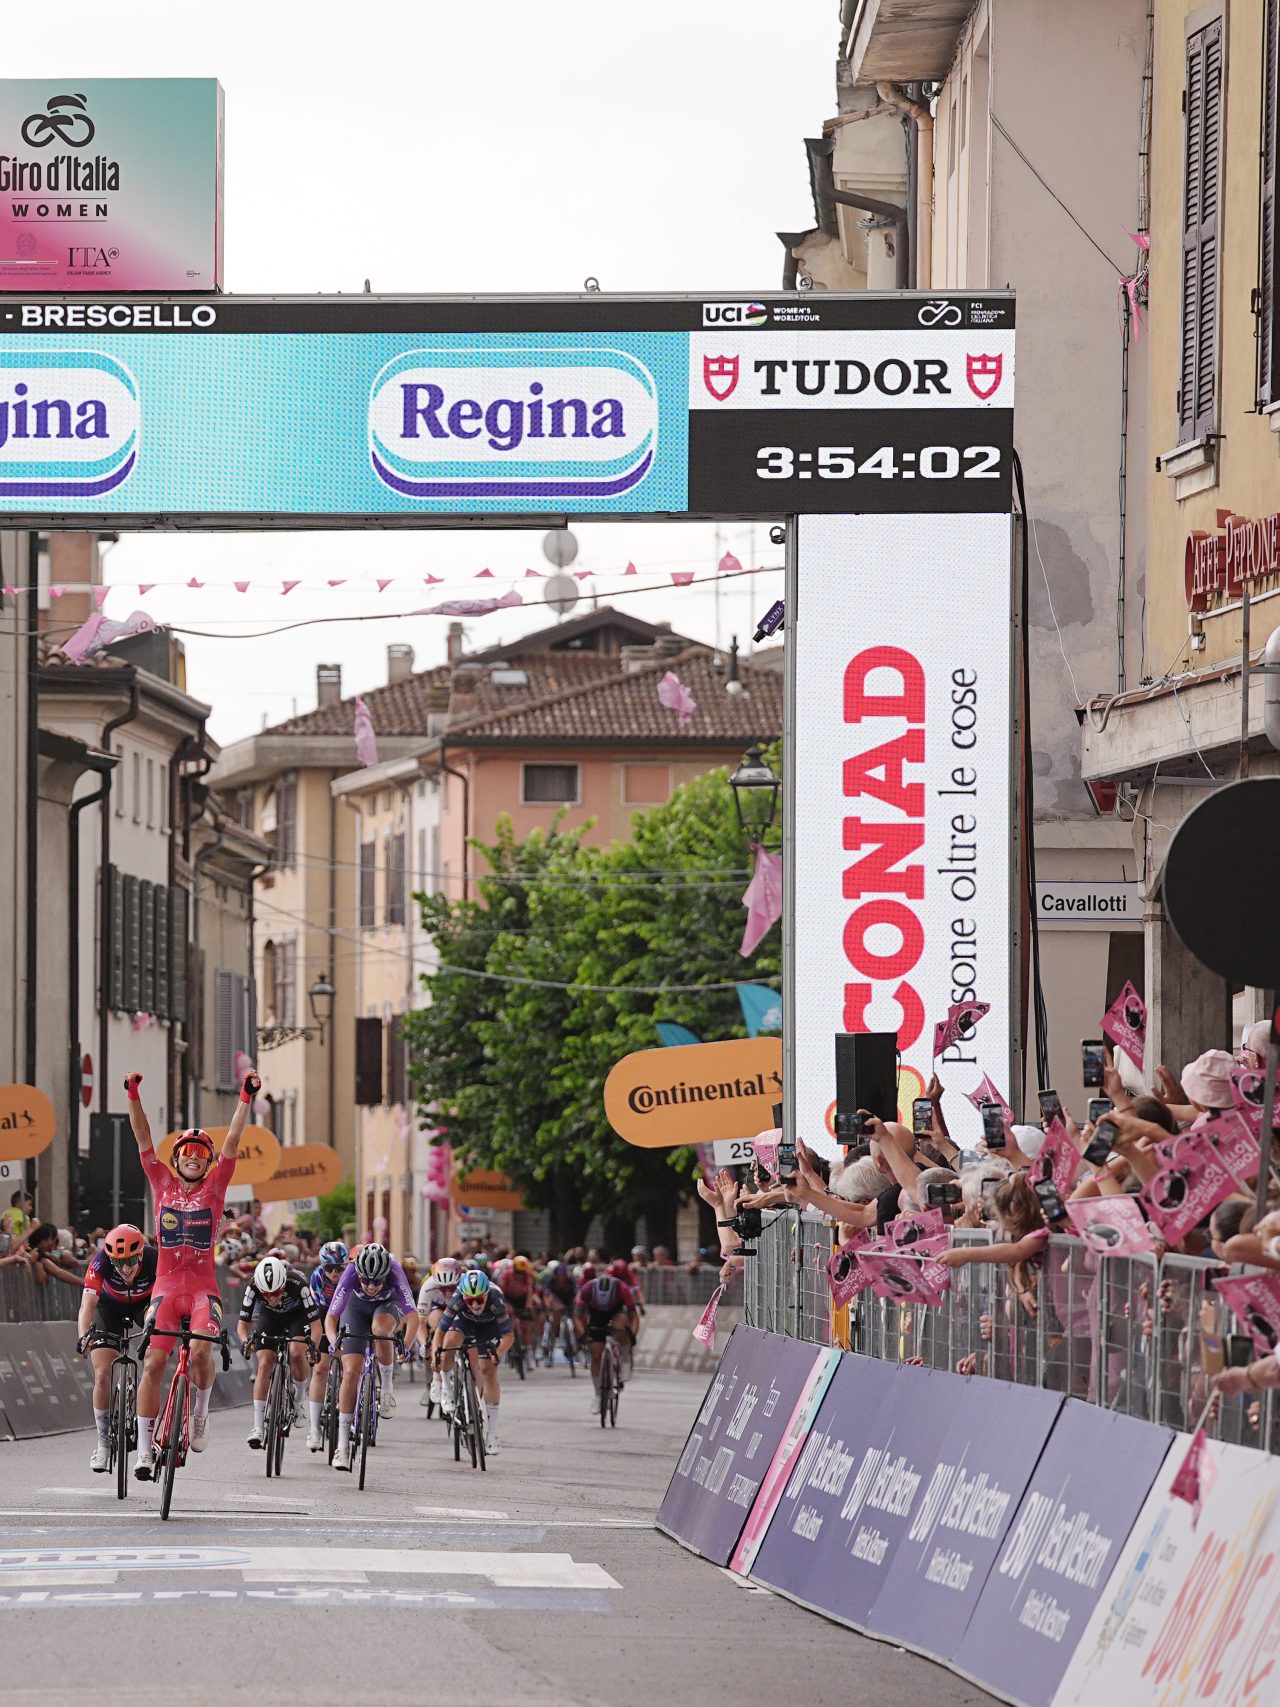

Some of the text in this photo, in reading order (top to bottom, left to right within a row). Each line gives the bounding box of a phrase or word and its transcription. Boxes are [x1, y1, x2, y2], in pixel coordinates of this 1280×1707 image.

[47, 155, 120, 191] d'Italia
[12, 204, 108, 217] WOMEN
[67, 247, 111, 268] ITA
[21, 305, 217, 328] BRESCELLO
[706, 307, 741, 322] UCI
[754, 359, 952, 396] TUDOR
[400, 382, 626, 451] Regina
[756, 446, 1001, 479] 3:54:02
[767, 605, 784, 623] LYNX
[842, 645, 926, 1053] CONAD
[937, 668, 978, 1065] Pesone oltre le cose
[1041, 893, 1127, 913] Cavallotti
[628, 1074, 766, 1115] Continental
[731, 1142, 753, 1159] 25
[331, 1287, 346, 1311] Jayco
